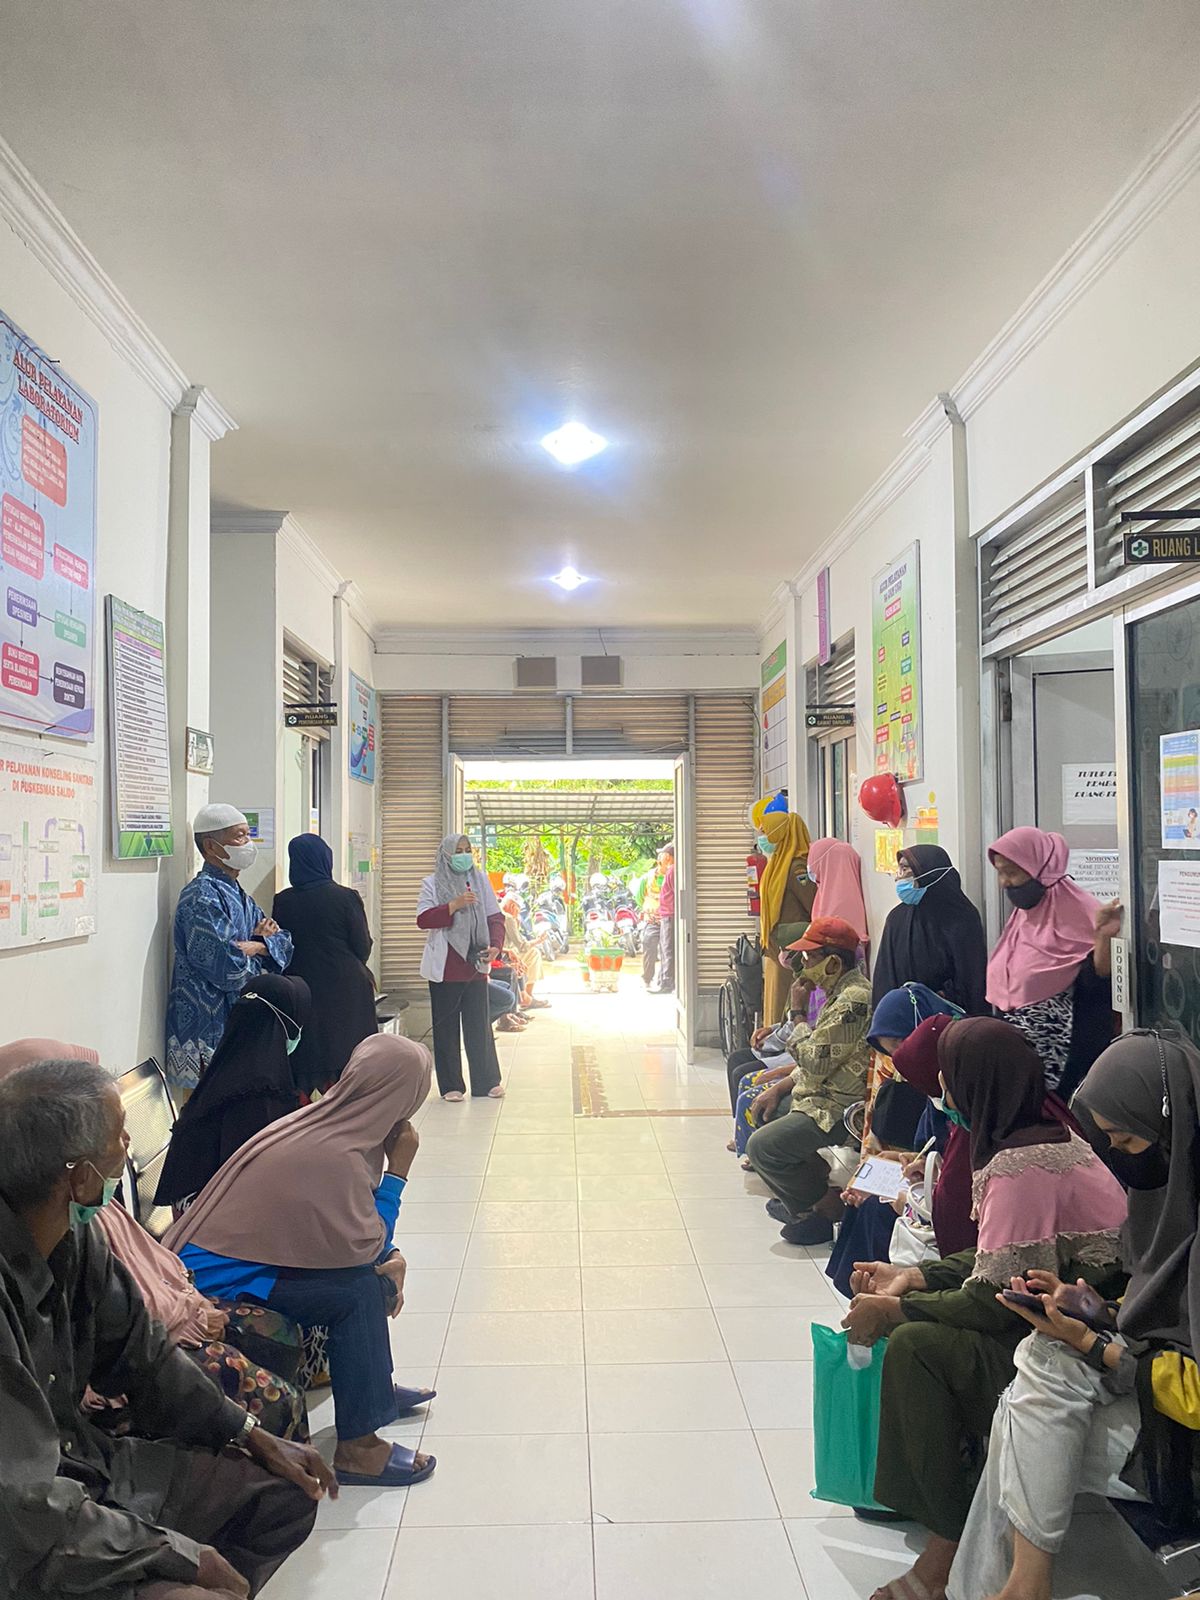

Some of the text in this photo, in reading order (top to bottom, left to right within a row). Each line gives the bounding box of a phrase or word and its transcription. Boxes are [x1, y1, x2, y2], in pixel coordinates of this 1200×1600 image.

[13, 349, 83, 426] ALUR PELAYANAN
[17, 375, 79, 444] LABORATORIUM
[1152, 537, 1191, 557] RUANG
[6, 760, 41, 777] PELAYANAN
[41, 766, 72, 783] KONSELING
[72, 772, 94, 786] SANITASI
[12, 779, 20, 791] DI
[20, 780, 55, 796] PUSKESMAS
